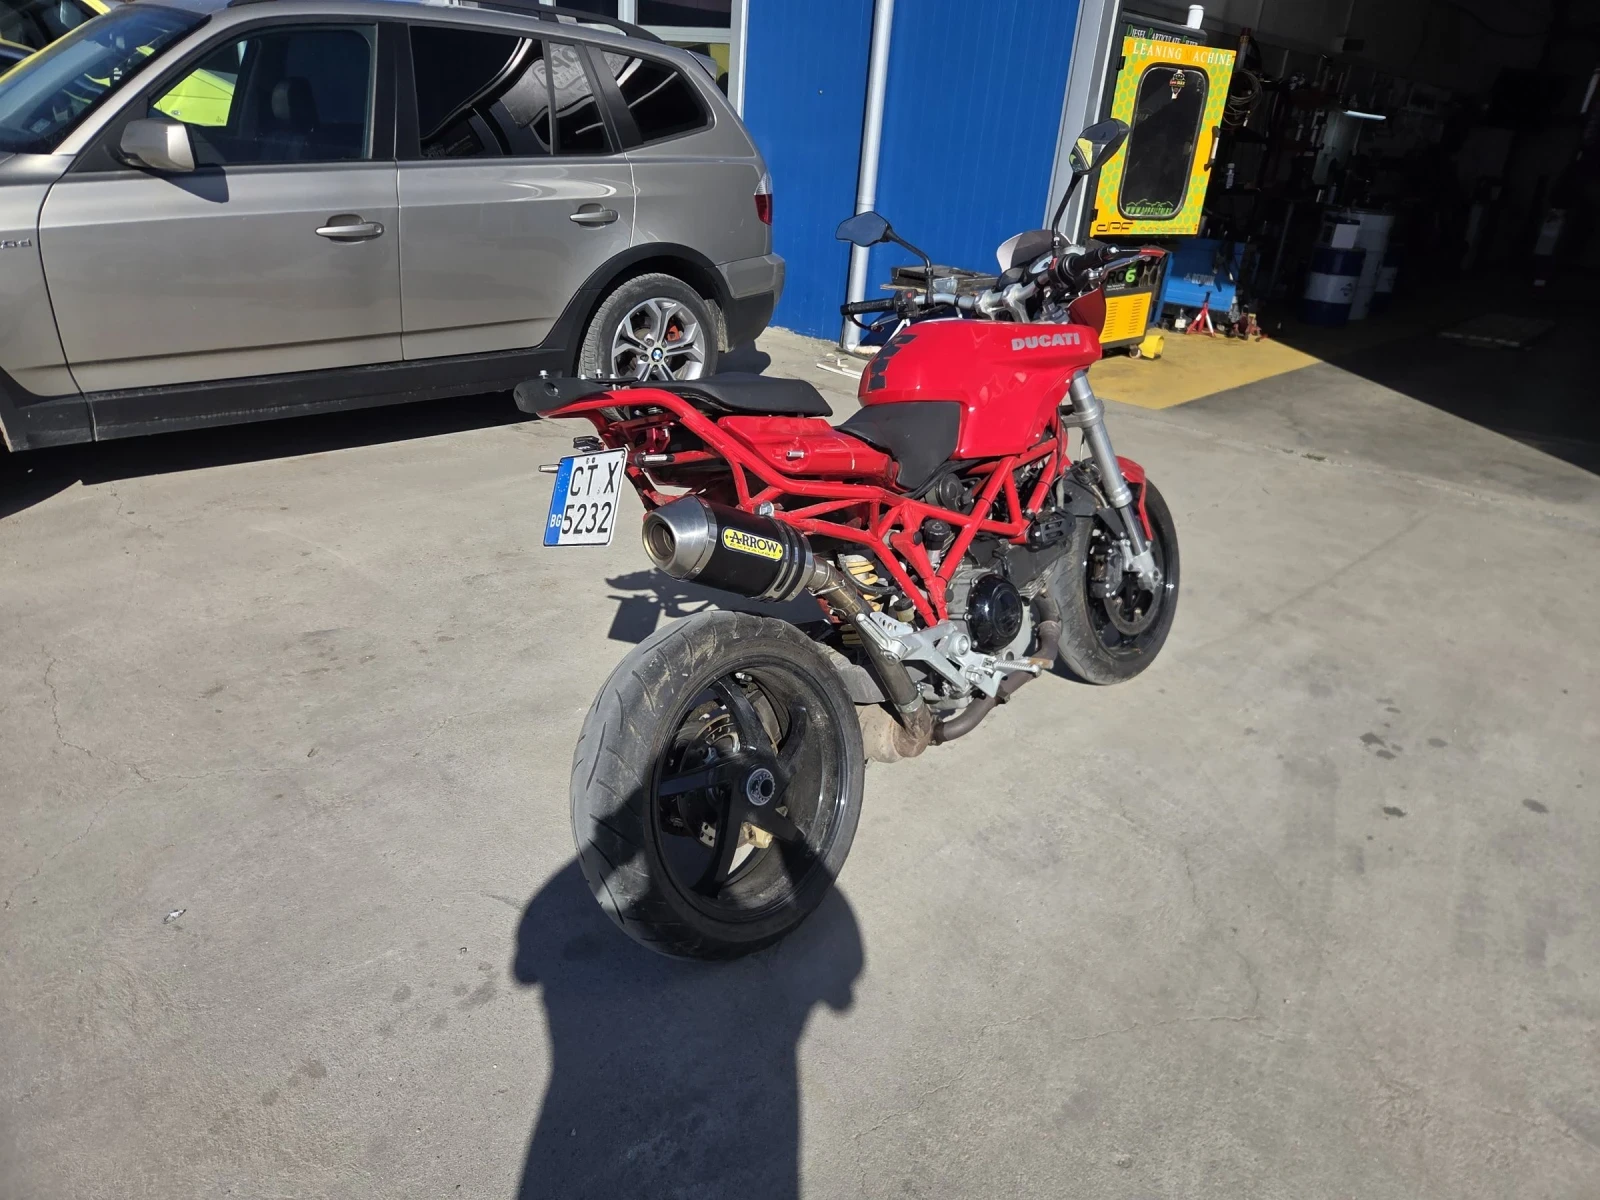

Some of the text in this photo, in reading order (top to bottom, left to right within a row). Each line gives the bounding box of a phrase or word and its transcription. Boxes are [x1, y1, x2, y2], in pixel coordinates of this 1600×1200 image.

[1126, 25, 1147, 39] DIESEL
[1011, 332, 1081, 351] DUCATI
[549, 514, 562, 528] BG
[561, 502, 613, 535] 5232
[729, 531, 779, 554] ARROW
